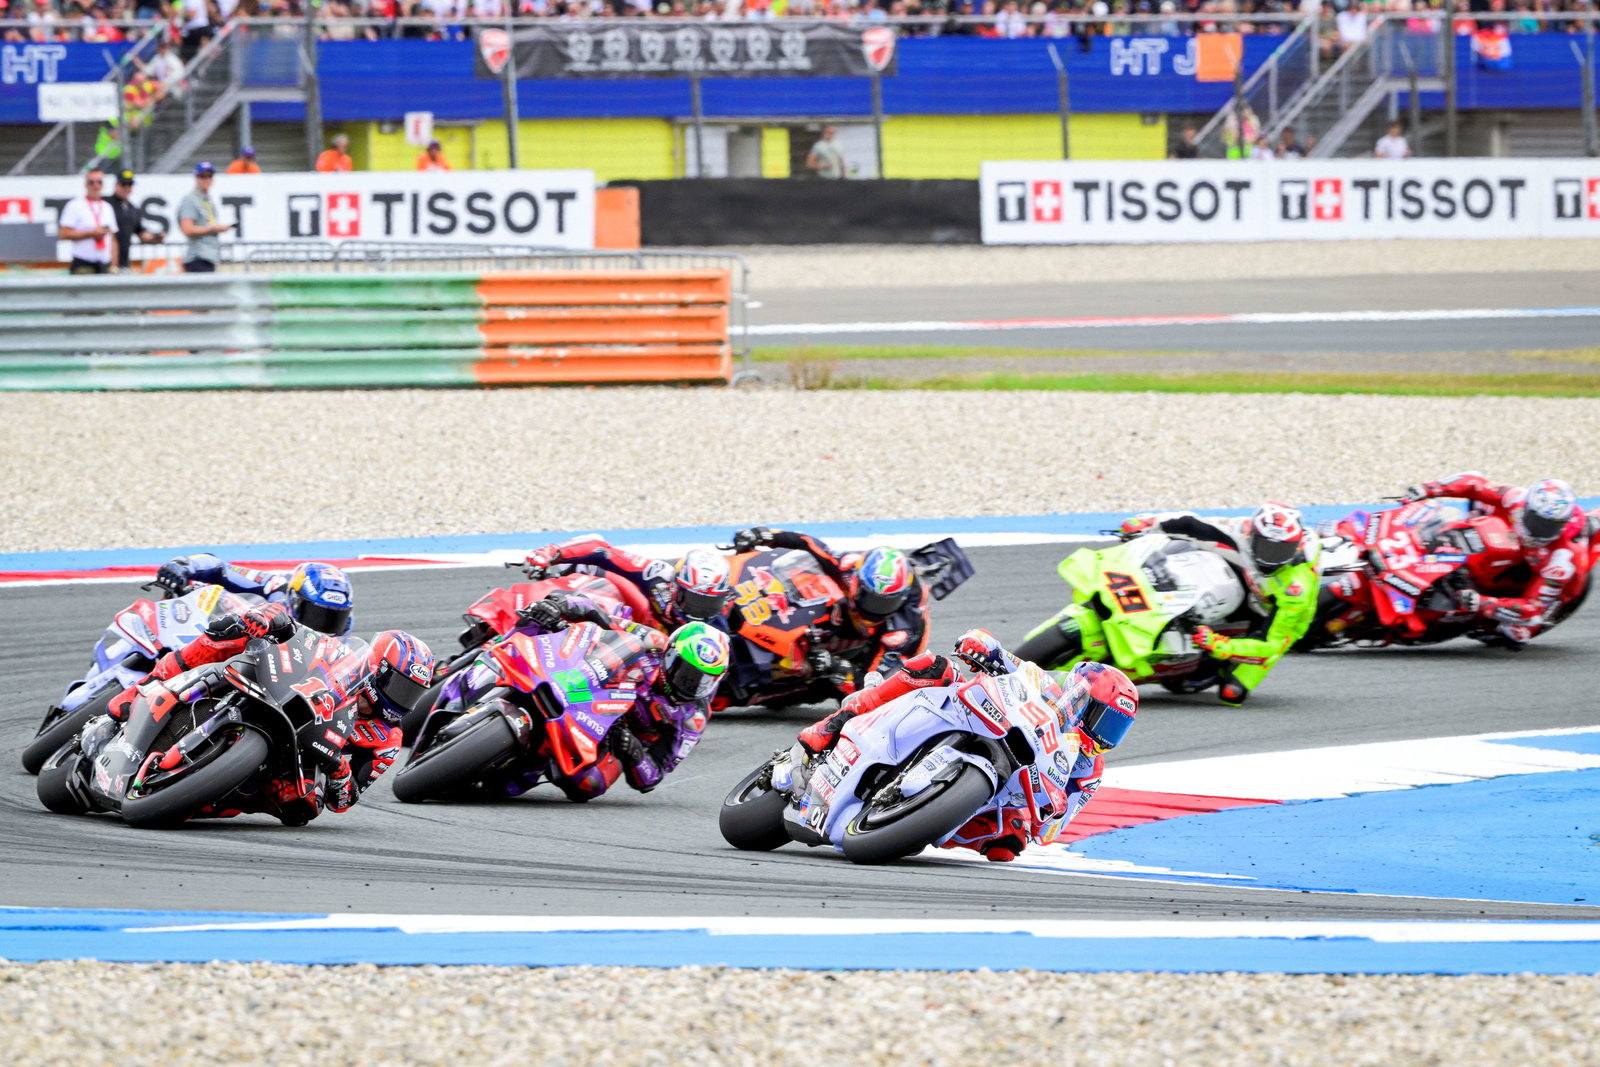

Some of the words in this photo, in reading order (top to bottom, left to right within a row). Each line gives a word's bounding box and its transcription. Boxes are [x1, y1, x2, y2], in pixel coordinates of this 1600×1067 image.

[371, 191, 577, 235] TISSOT
[1073, 180, 1251, 221] TISSOT
[1352, 178, 1526, 220] TISSOT
[1378, 531, 1421, 570] 23
[268, 653, 277, 675] CASE
[538, 635, 556, 668] prima
[997, 676, 1013, 707] Unibat
[575, 710, 605, 736] prima
[983, 700, 1002, 720] BOLD
[1018, 700, 1060, 755] 93
[312, 741, 329, 754] CASE
[1047, 766, 1066, 788] Unibat
